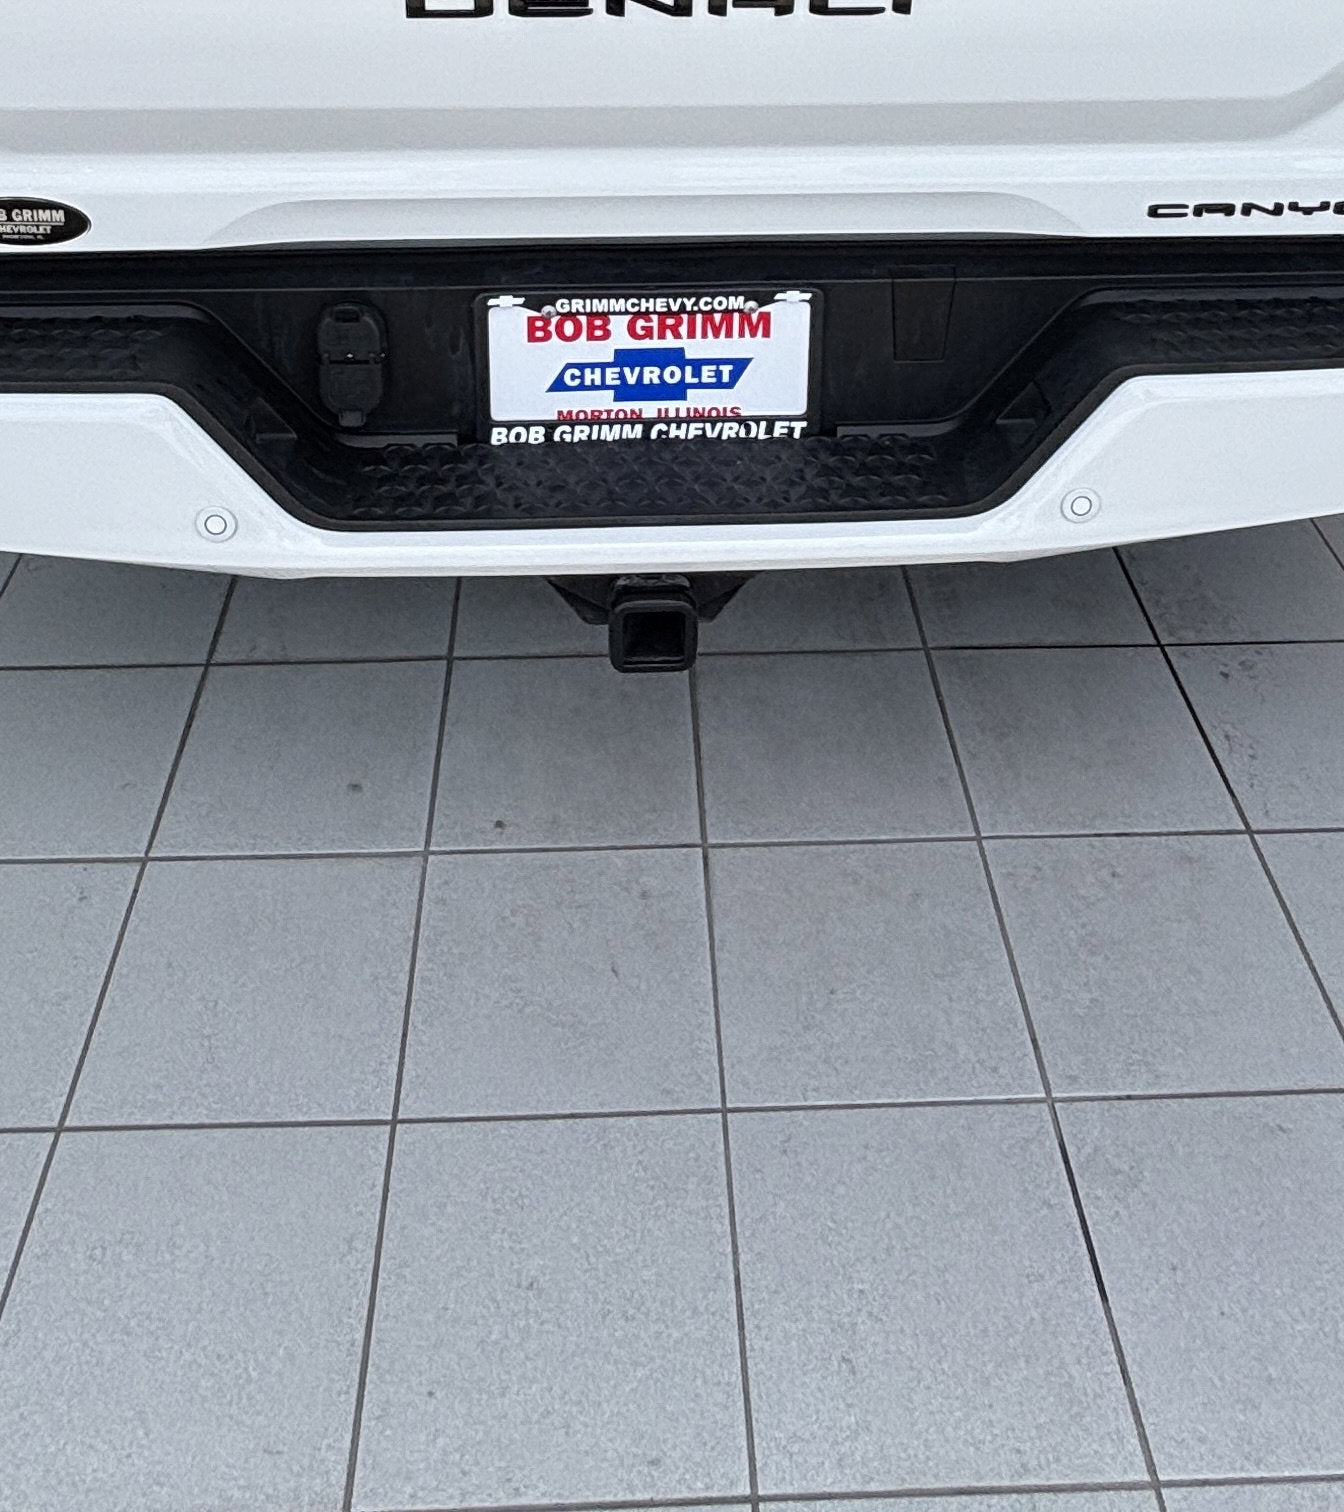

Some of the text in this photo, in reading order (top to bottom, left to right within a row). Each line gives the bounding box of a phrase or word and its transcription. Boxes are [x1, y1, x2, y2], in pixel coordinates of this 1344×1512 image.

[11, 209, 65, 223] GRIMM
[555, 295, 745, 314] GRIMMCHEVY.COM
[526, 311, 772, 343] BOB GRIMM
[562, 364, 734, 387] CHEVROLET
[557, 408, 643, 421] MORTON
[490, 421, 808, 445] BOB GRIMM CHEVROLET
